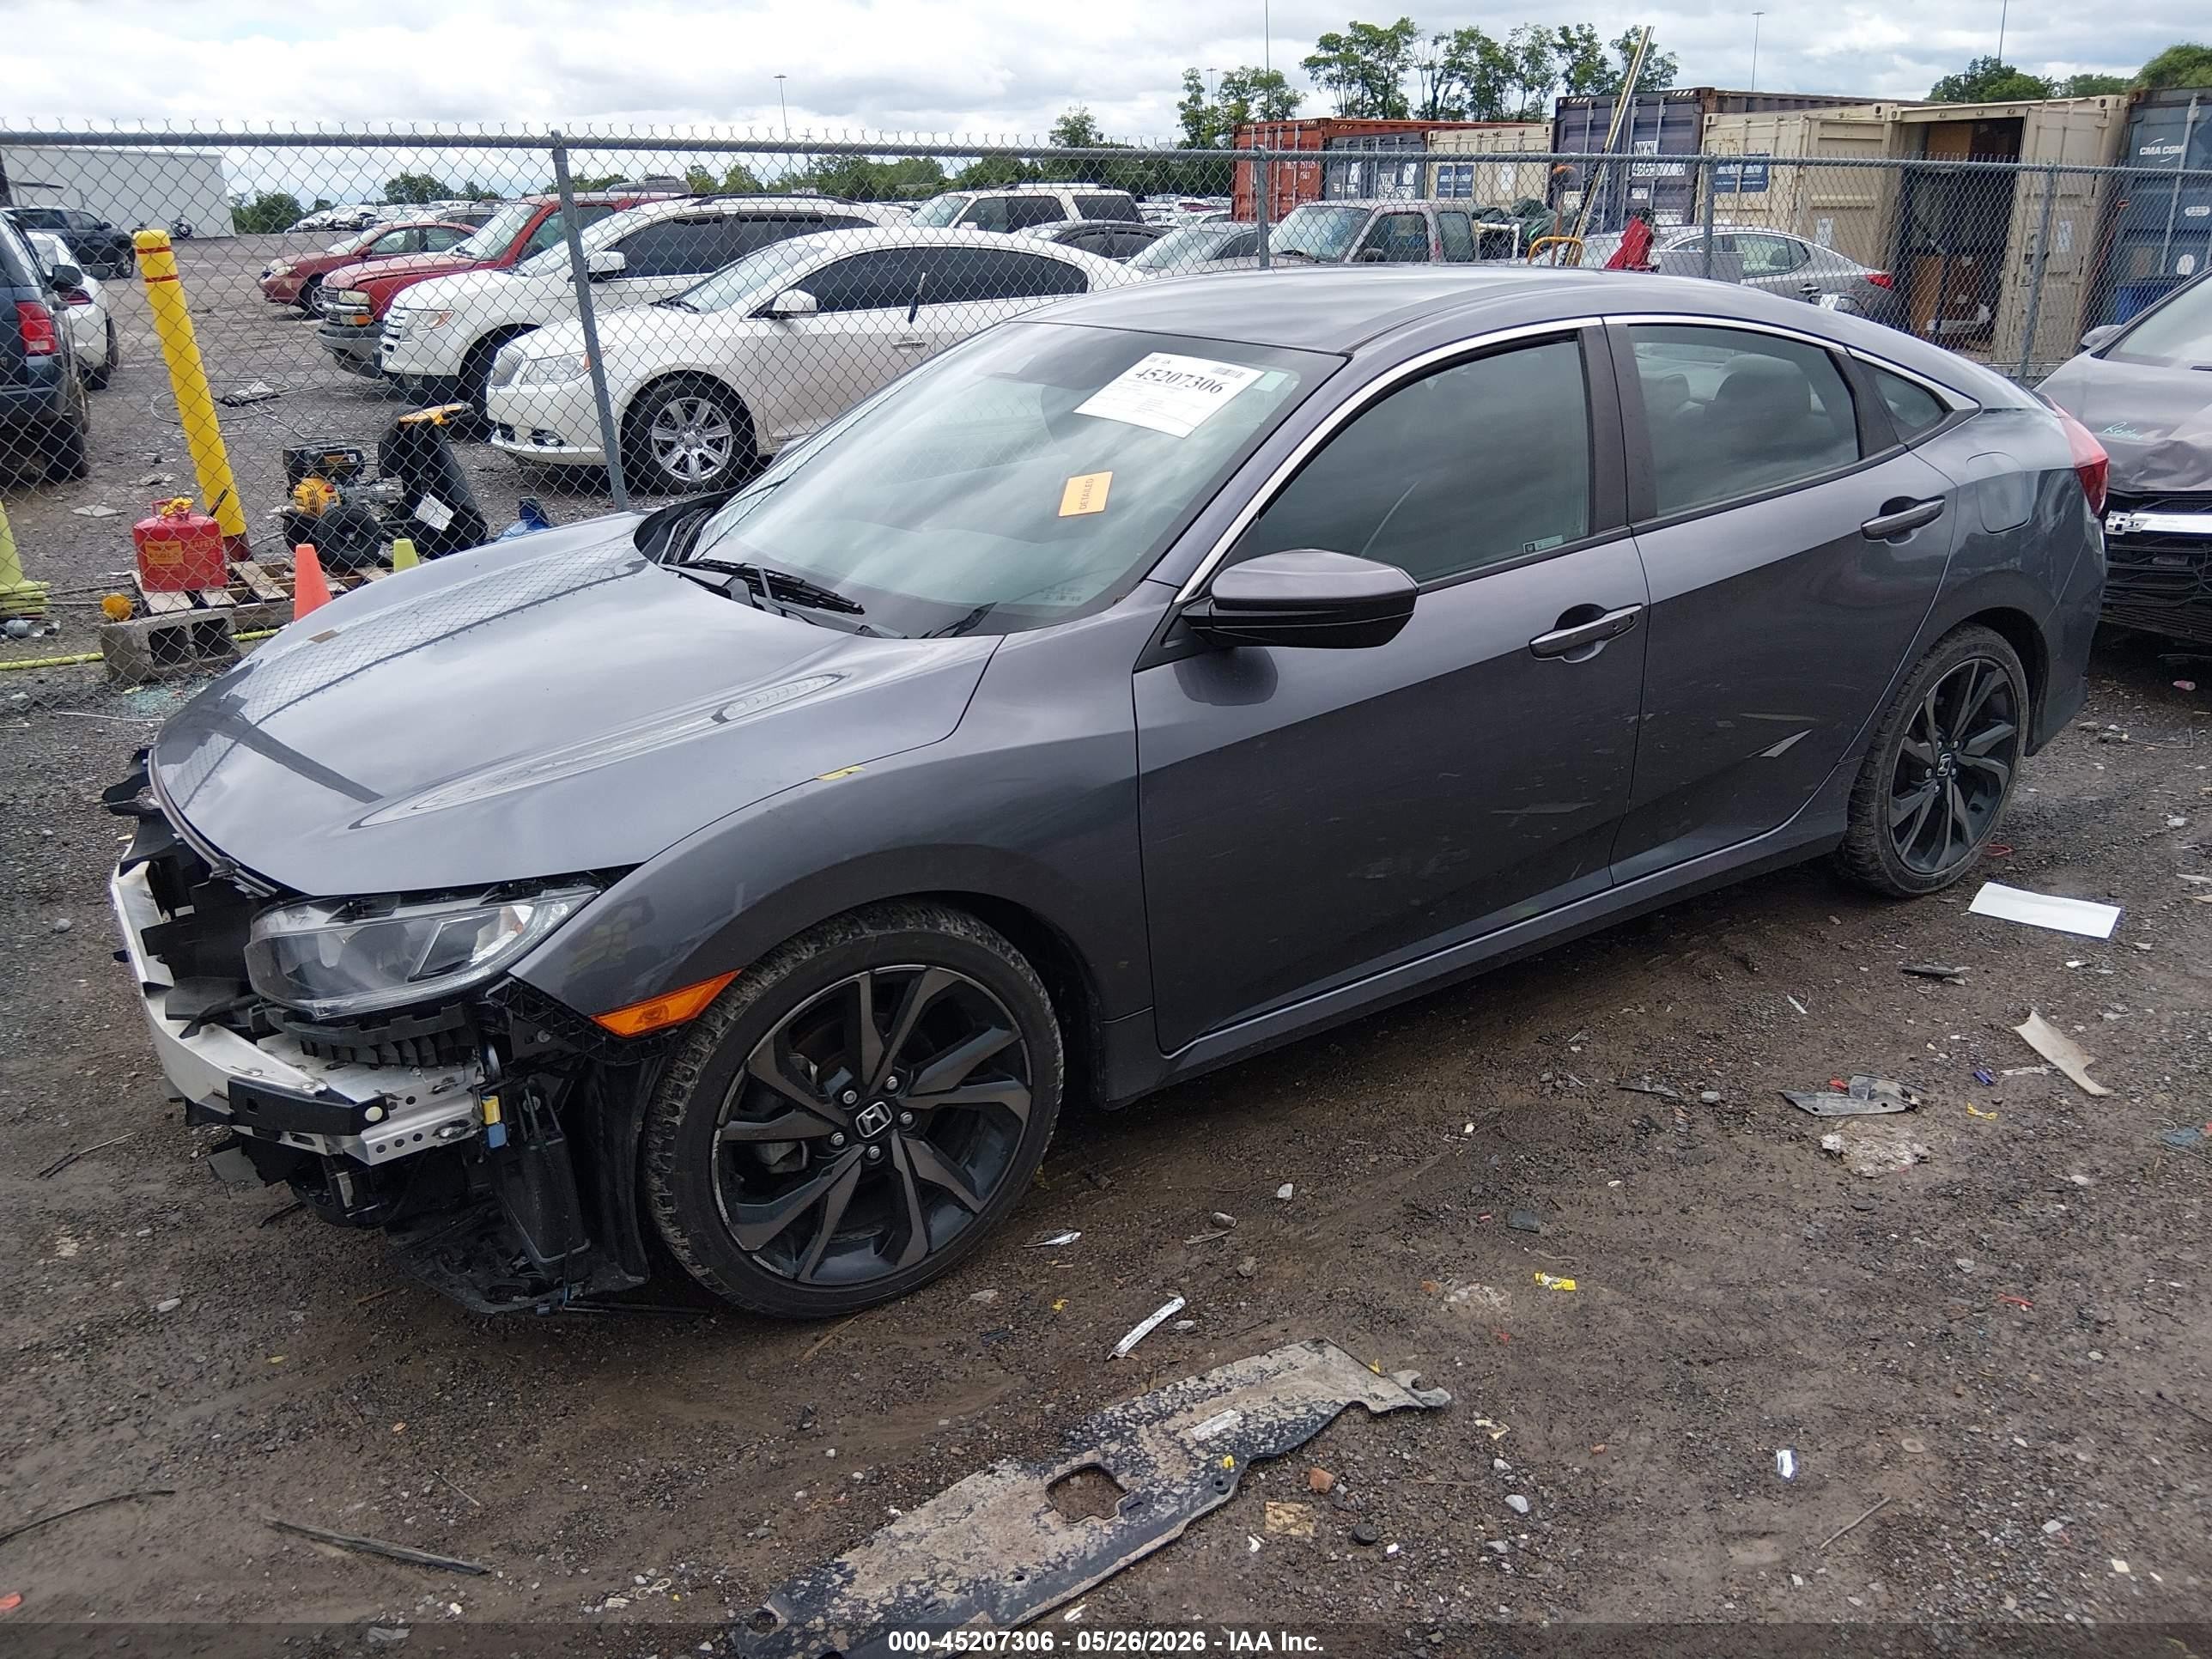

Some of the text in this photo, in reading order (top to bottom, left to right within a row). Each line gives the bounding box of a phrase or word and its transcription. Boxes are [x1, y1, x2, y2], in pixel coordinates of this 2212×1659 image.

[2139, 146, 2160, 155] CMA
[1135, 368, 1230, 394] 45207306
[1079, 478, 1094, 509] DETAILED
